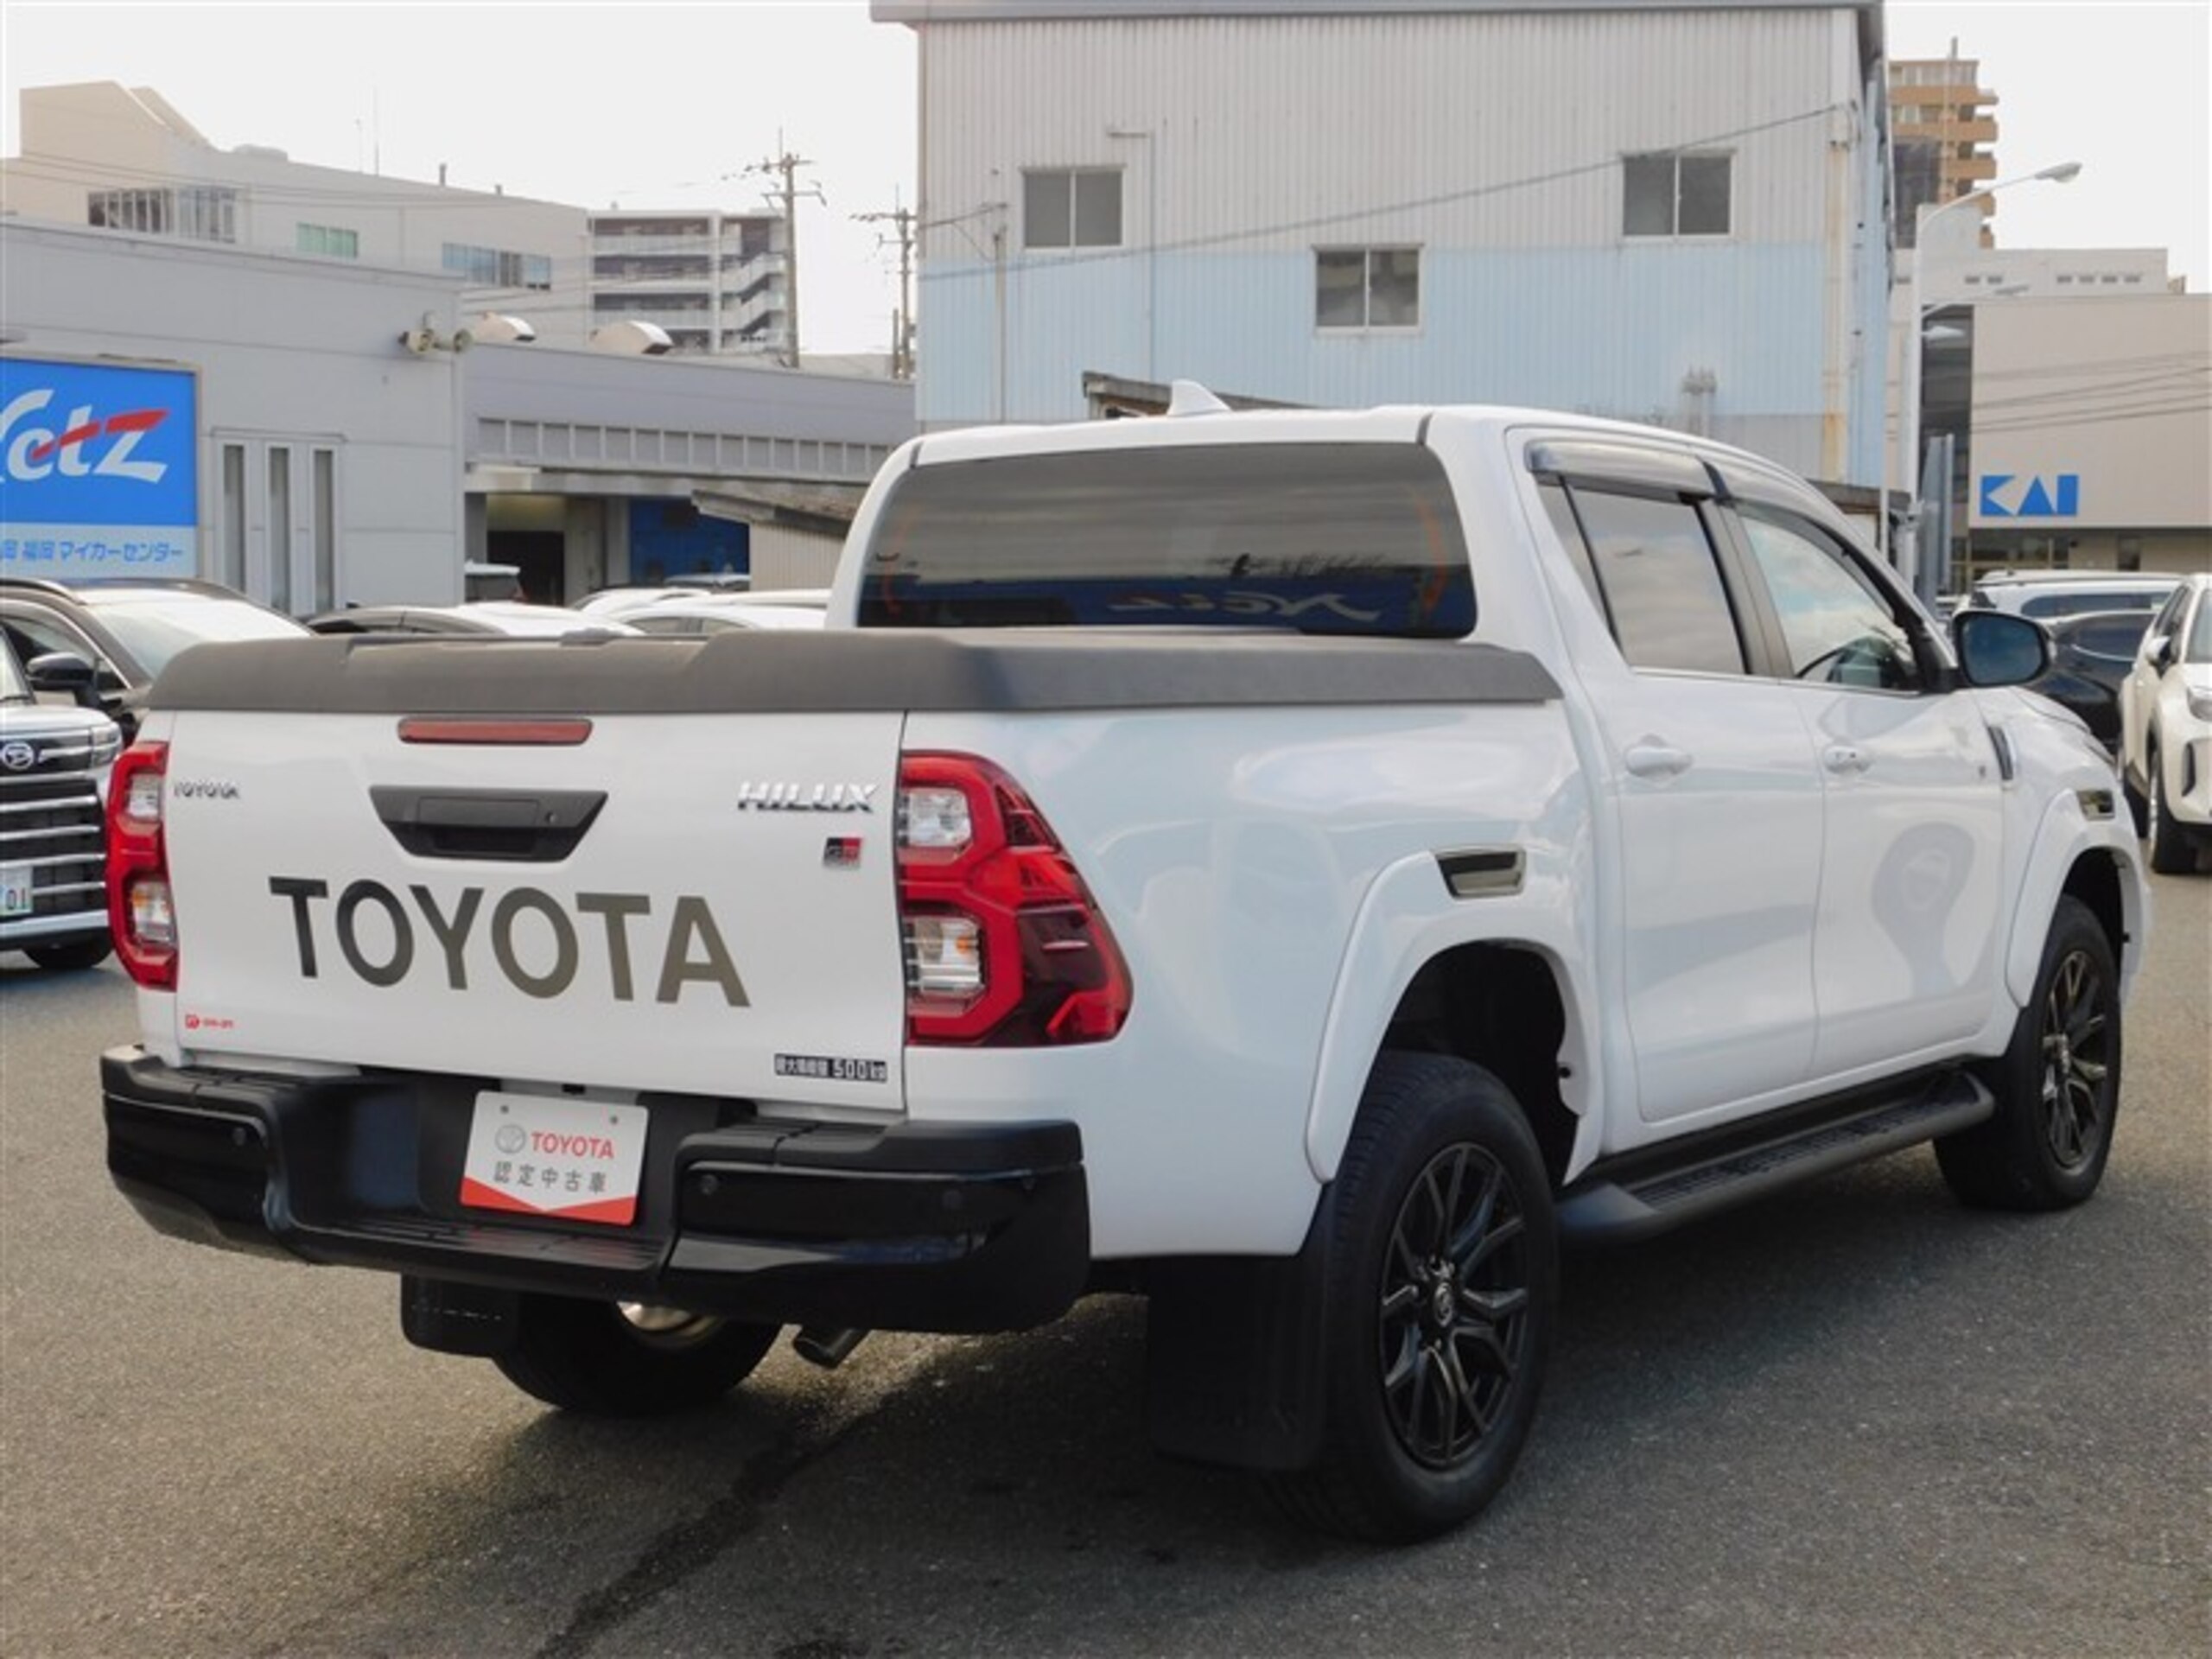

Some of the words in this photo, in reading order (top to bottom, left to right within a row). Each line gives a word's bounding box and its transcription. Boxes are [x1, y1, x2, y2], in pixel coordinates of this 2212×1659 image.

[1980, 474, 2079, 517] KAI
[738, 781, 879, 812] HILUX
[269, 876, 750, 1008] TOYOTA
[531, 1131, 614, 1160] TOYOTA
[493, 1160, 607, 1194] 認定中古車
